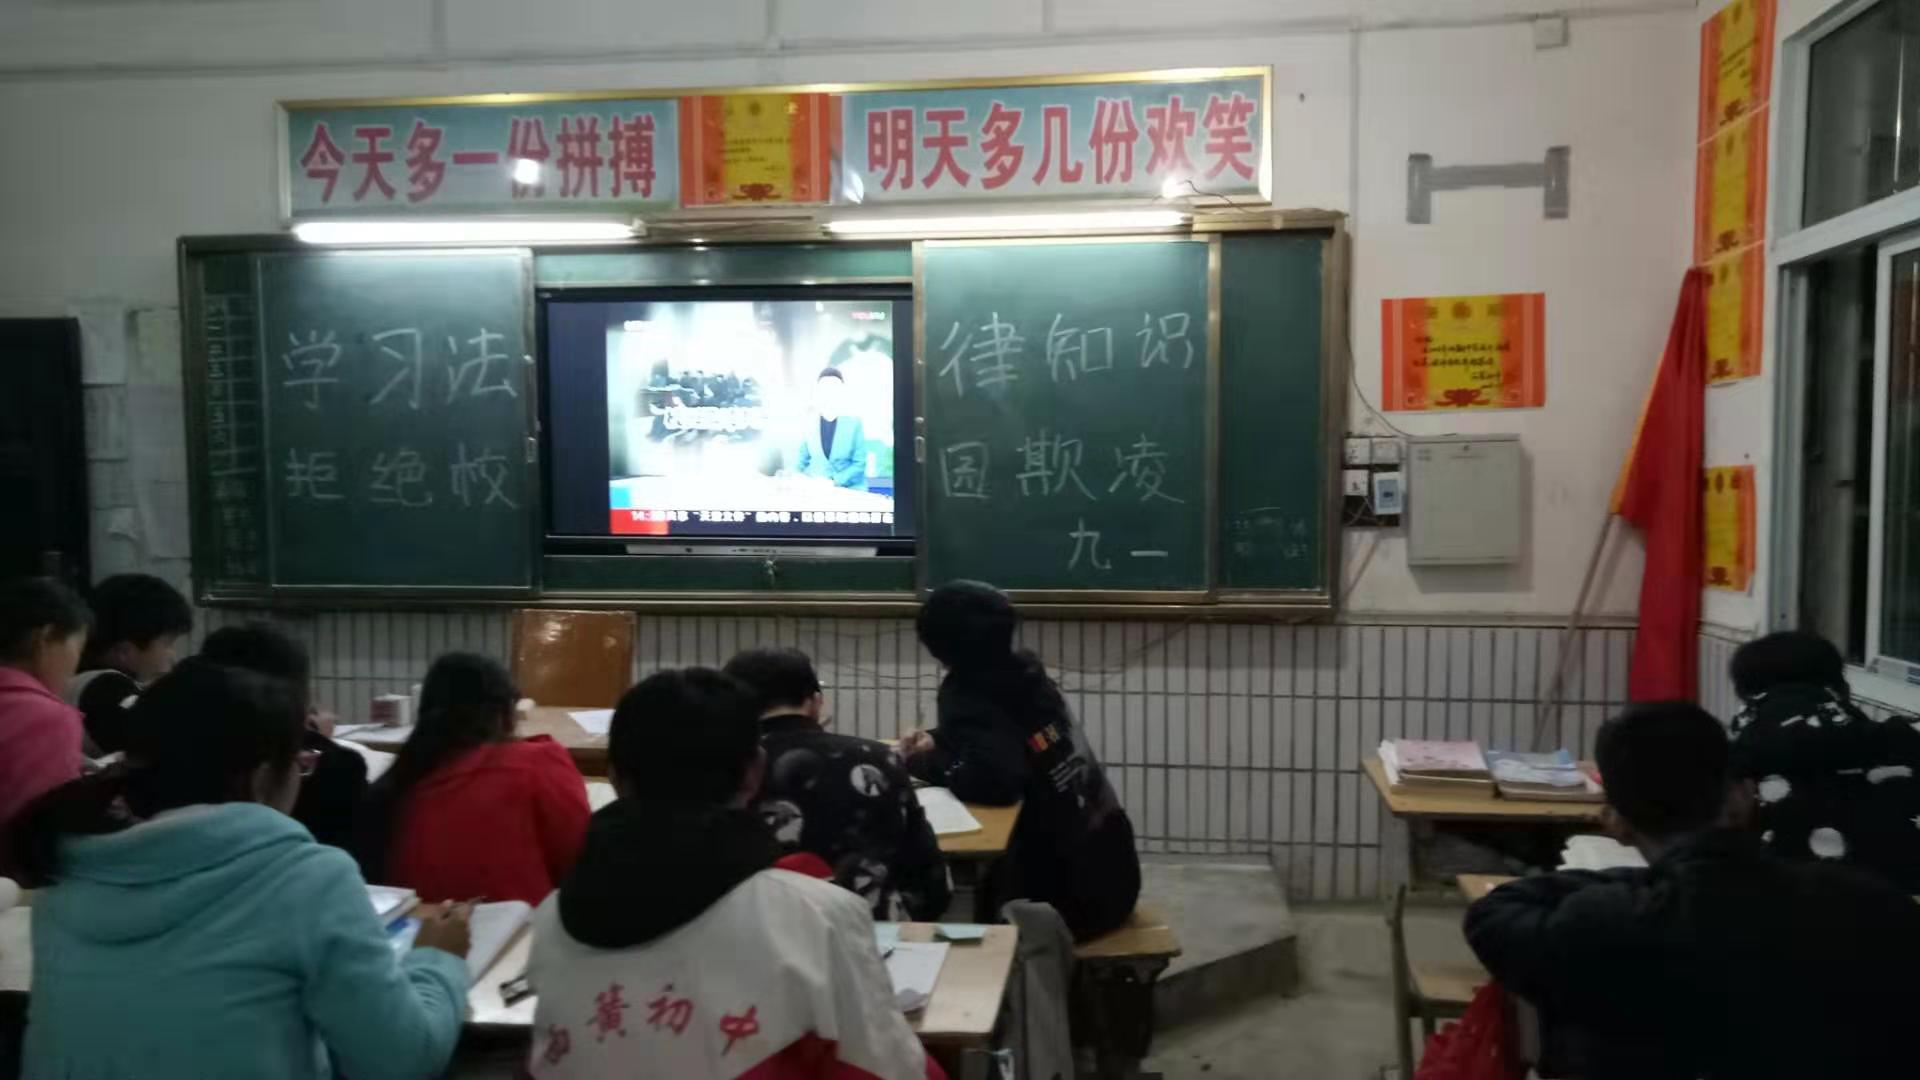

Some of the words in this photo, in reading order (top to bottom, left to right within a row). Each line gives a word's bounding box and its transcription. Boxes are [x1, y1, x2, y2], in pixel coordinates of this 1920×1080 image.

[300, 114, 656, 202] 今天多一份拼搏
[867, 93, 1255, 191] 明天多几份欢笑
[283, 328, 517, 410] 学习法
[939, 313, 1194, 396] 律知识
[285, 443, 518, 508] 拒绝校
[939, 430, 1184, 503] 园欺凌
[1068, 518, 1168, 570] 九一
